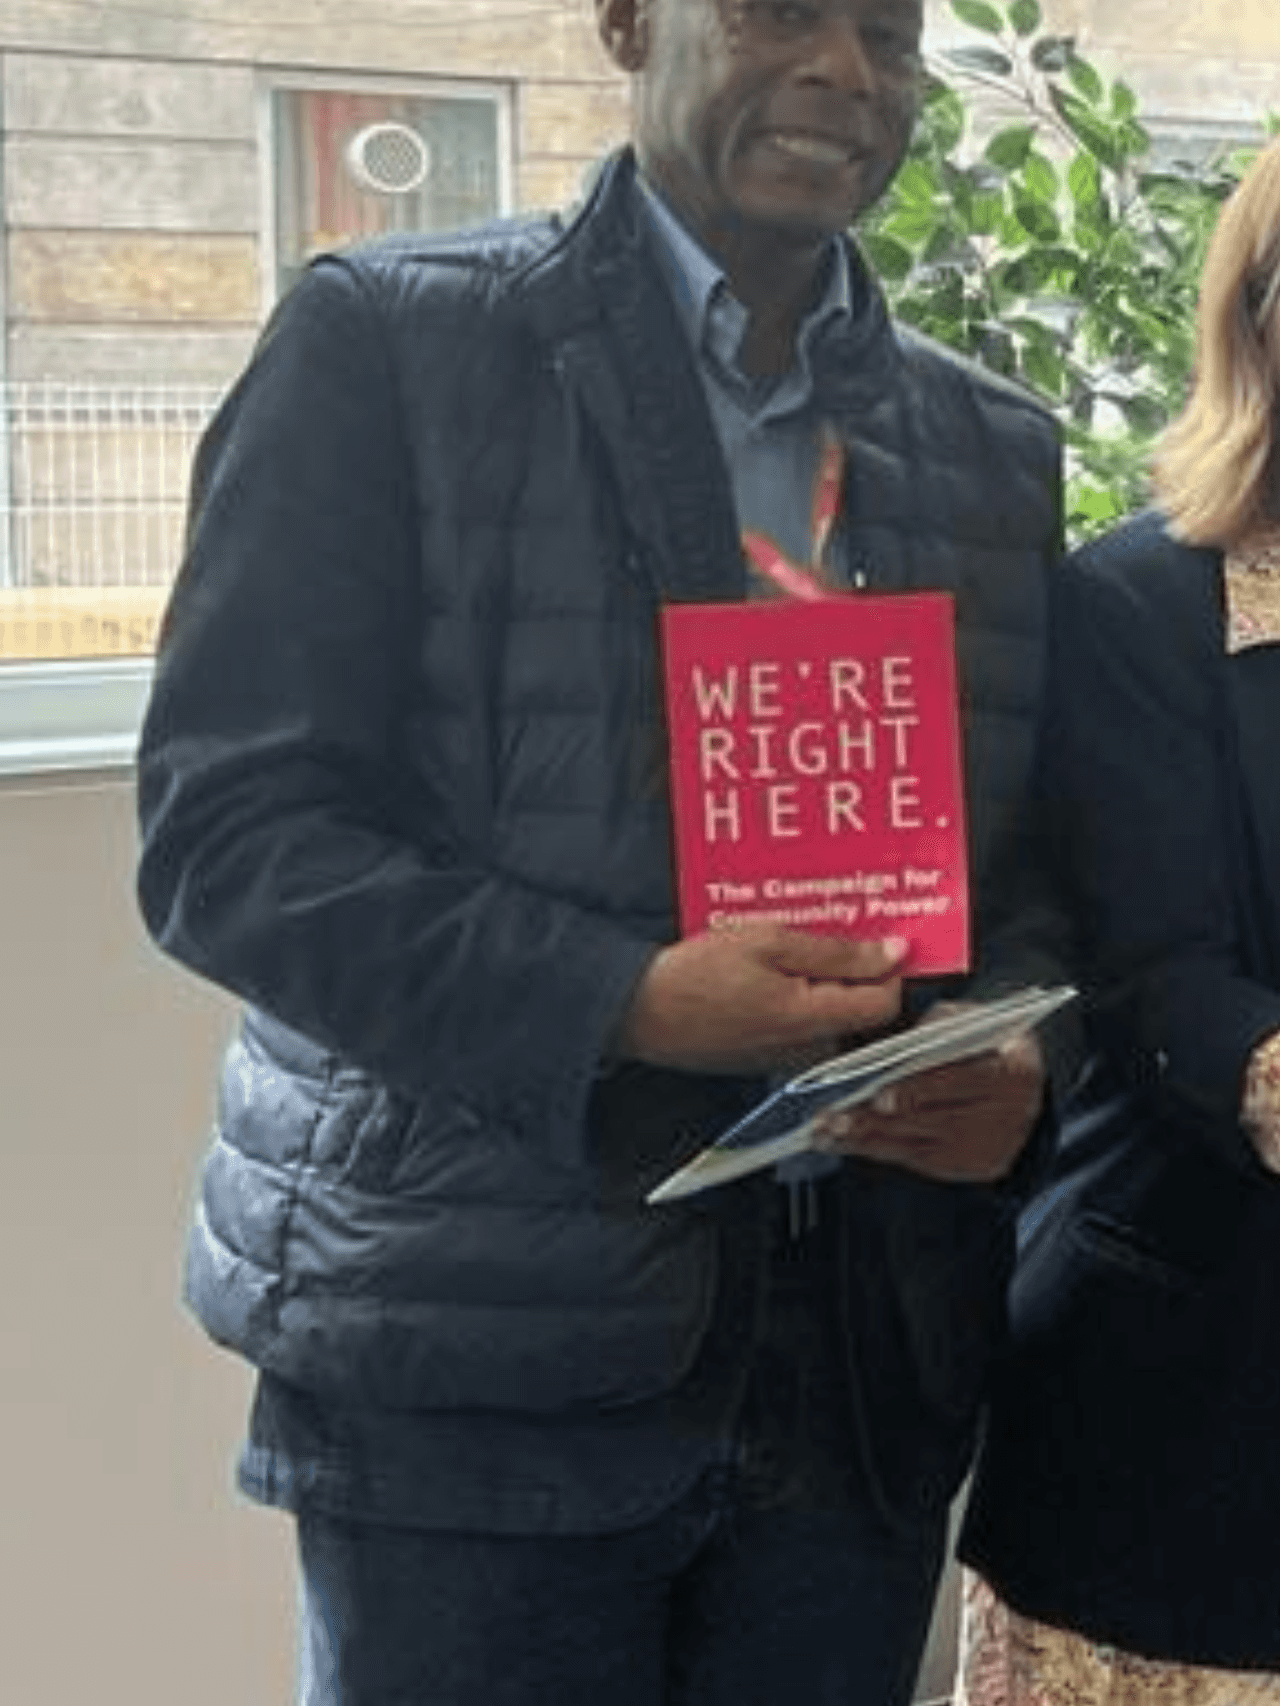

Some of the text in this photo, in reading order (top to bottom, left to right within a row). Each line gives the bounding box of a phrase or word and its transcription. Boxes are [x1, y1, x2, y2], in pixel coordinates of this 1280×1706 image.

[691, 656, 917, 721] WE'RE
[703, 716, 919, 780] RIGHT
[704, 776, 949, 842] HERE.
[705, 865, 942, 902] The Campaign for
[866, 896, 951, 917] Power
